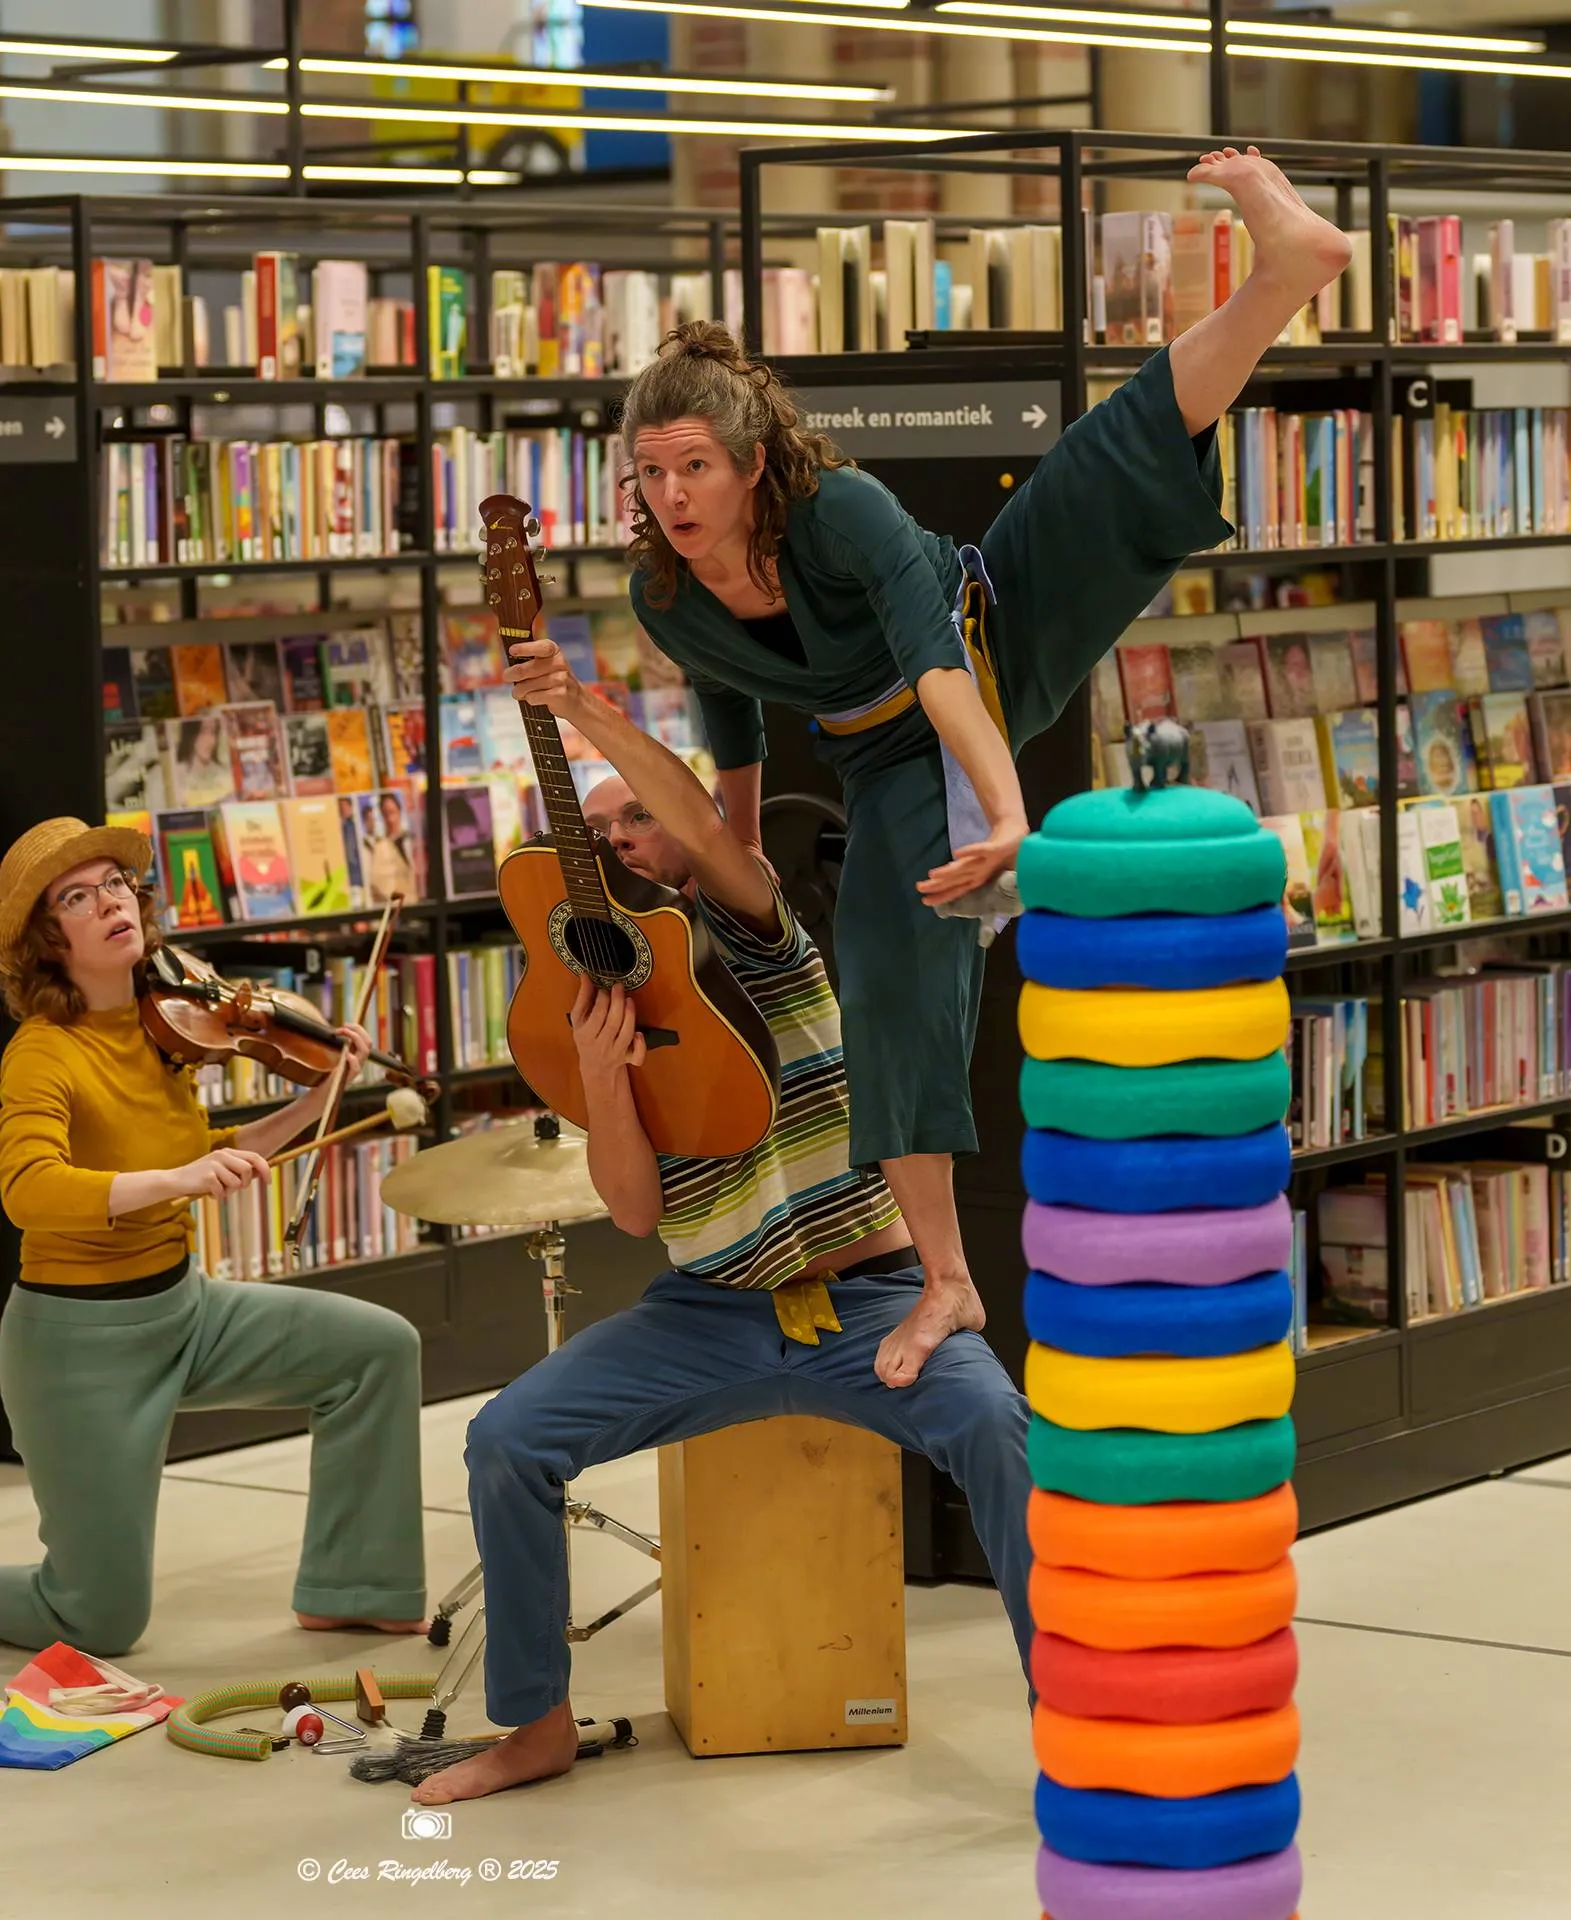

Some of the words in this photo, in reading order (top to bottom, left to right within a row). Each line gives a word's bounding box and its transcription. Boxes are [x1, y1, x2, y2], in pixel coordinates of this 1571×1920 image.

[1408, 381, 1428, 408] C
[806, 406, 865, 429] streek
[868, 410, 891, 427] en
[894, 404, 993, 427] romantiek
[1546, 1133, 1567, 1159] D
[848, 1707, 892, 1716] Millenium
